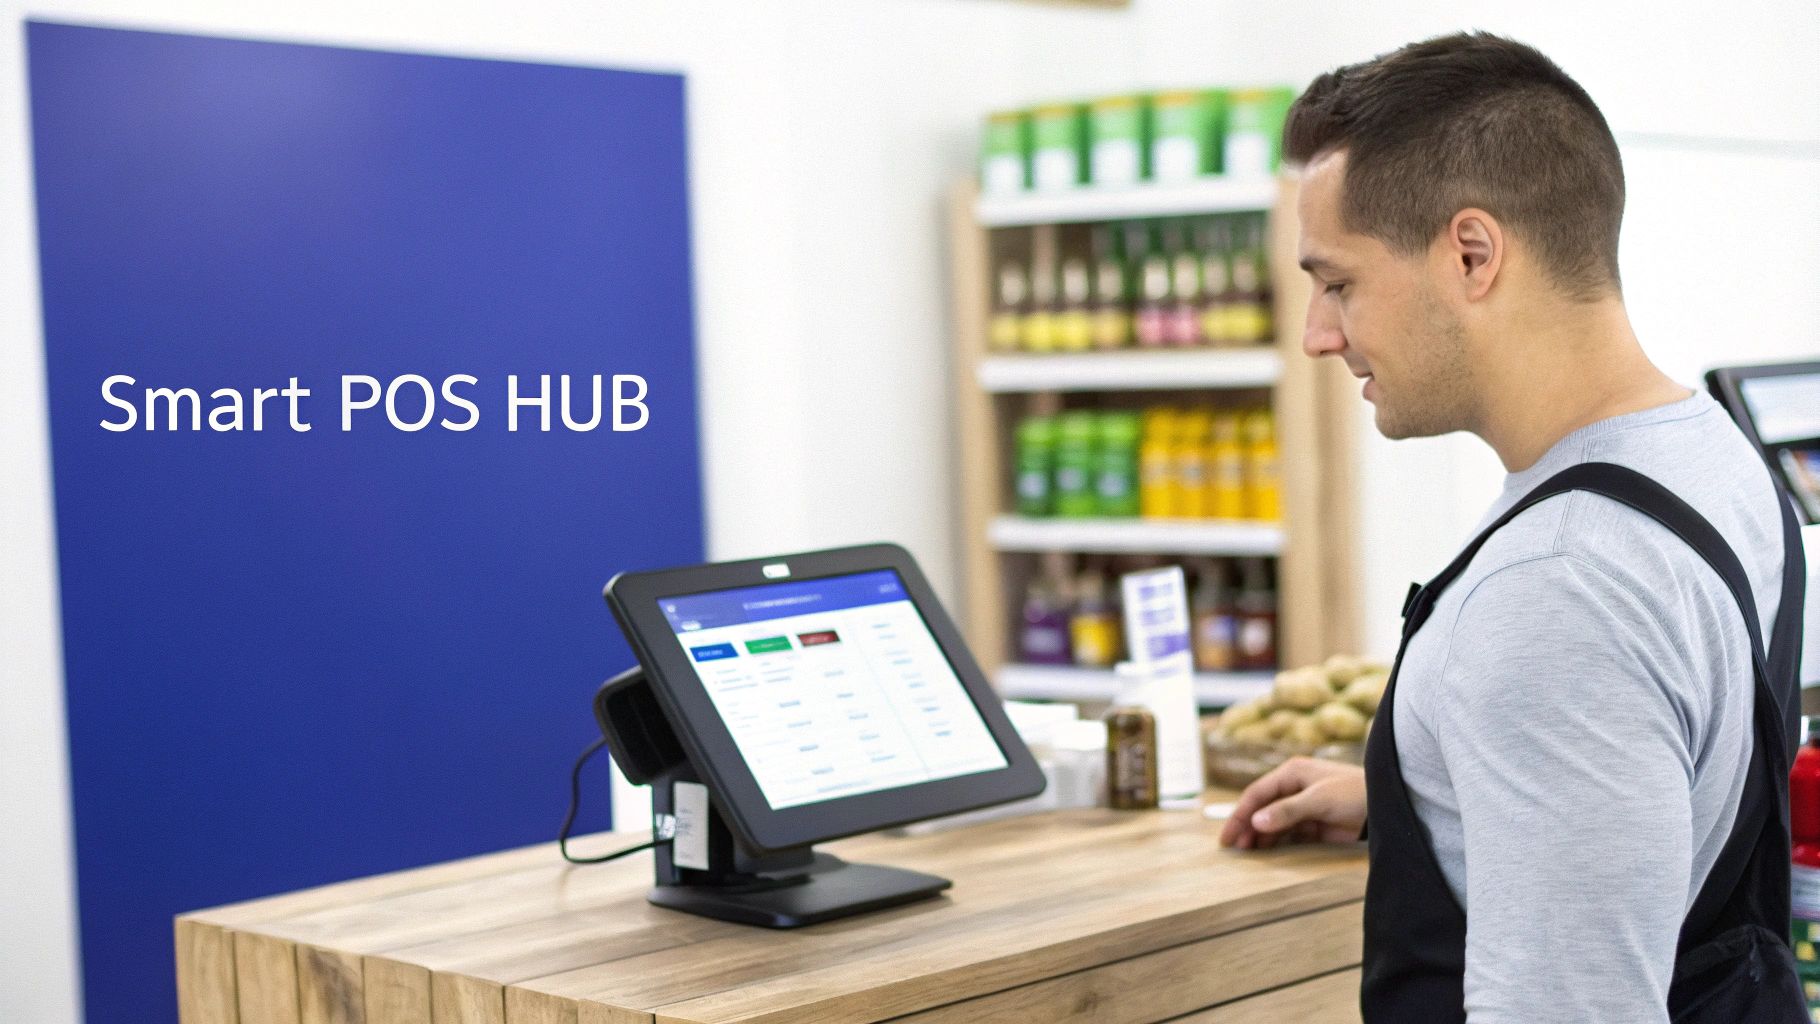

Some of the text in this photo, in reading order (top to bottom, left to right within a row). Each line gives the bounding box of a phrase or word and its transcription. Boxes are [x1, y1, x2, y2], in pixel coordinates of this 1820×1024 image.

[100, 373, 650, 432] Smart POS HUB
